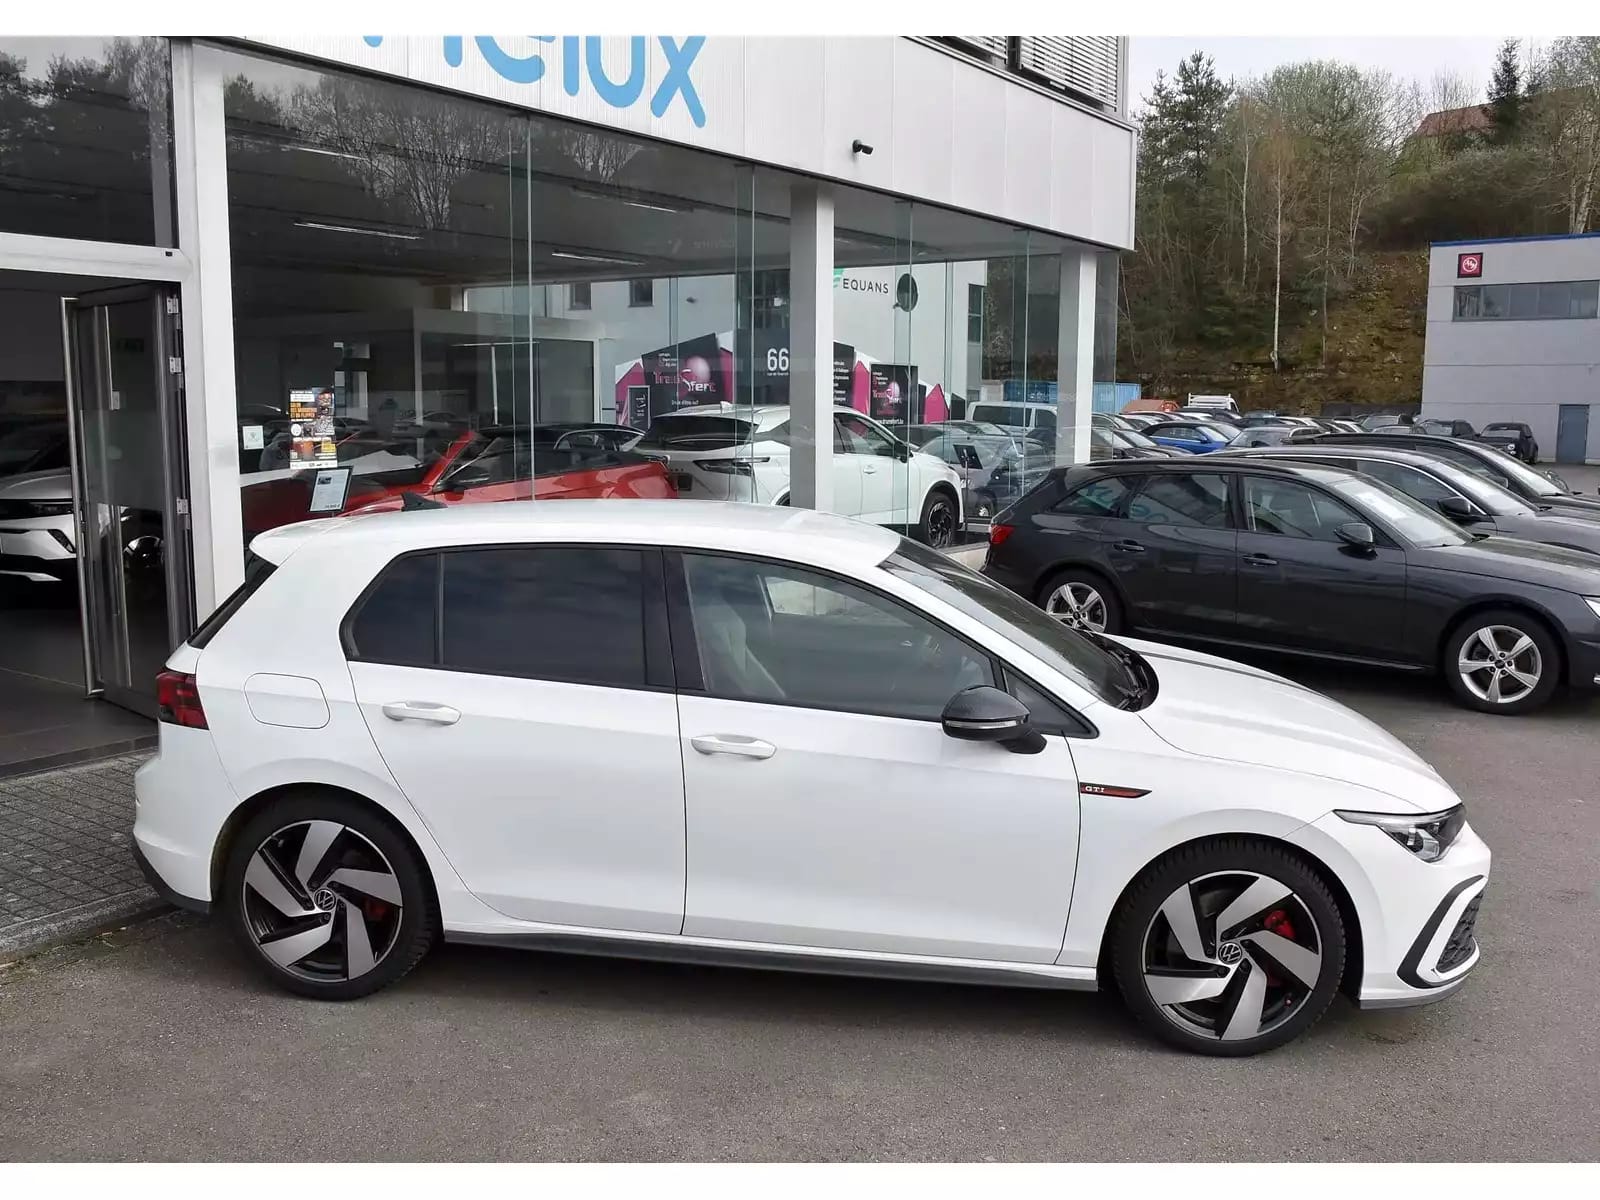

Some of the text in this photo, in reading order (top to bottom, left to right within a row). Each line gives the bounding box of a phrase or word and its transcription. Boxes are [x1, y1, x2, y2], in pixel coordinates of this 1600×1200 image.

[842, 277, 889, 295] EQUANS
[766, 347, 790, 371] 66
[1085, 785, 1105, 793] GTI
